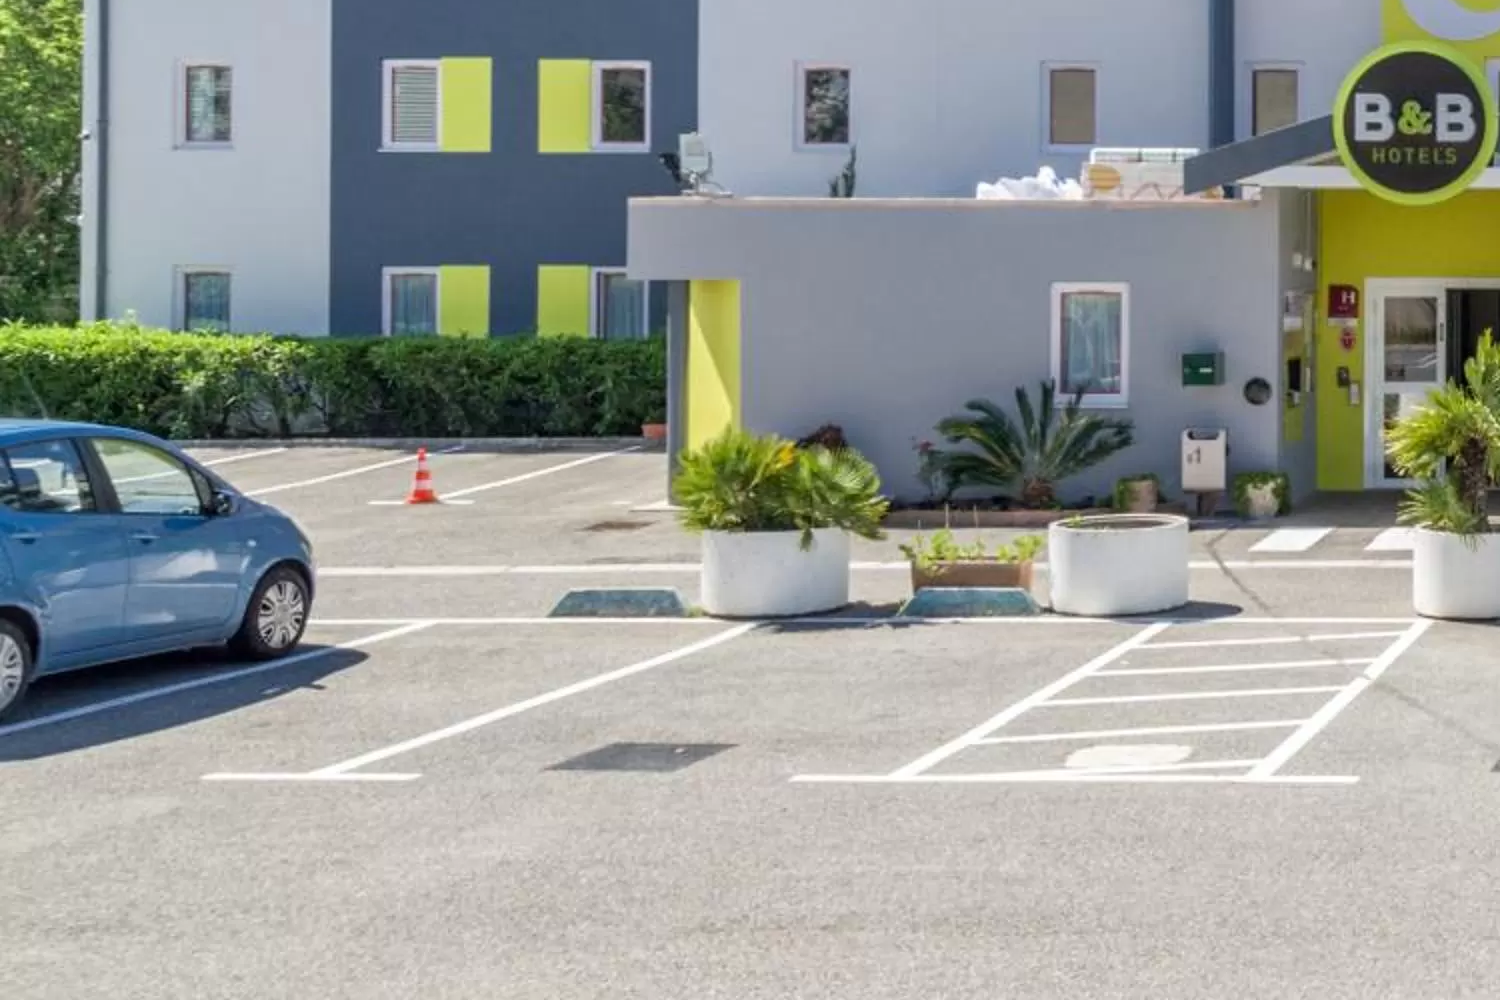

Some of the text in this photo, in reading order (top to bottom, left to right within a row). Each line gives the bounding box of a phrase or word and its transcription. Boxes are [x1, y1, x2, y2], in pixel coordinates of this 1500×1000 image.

[1354, 92, 1477, 143] B&B
[1372, 147, 1457, 165] HOTELS
[1341, 291, 1356, 305] H
